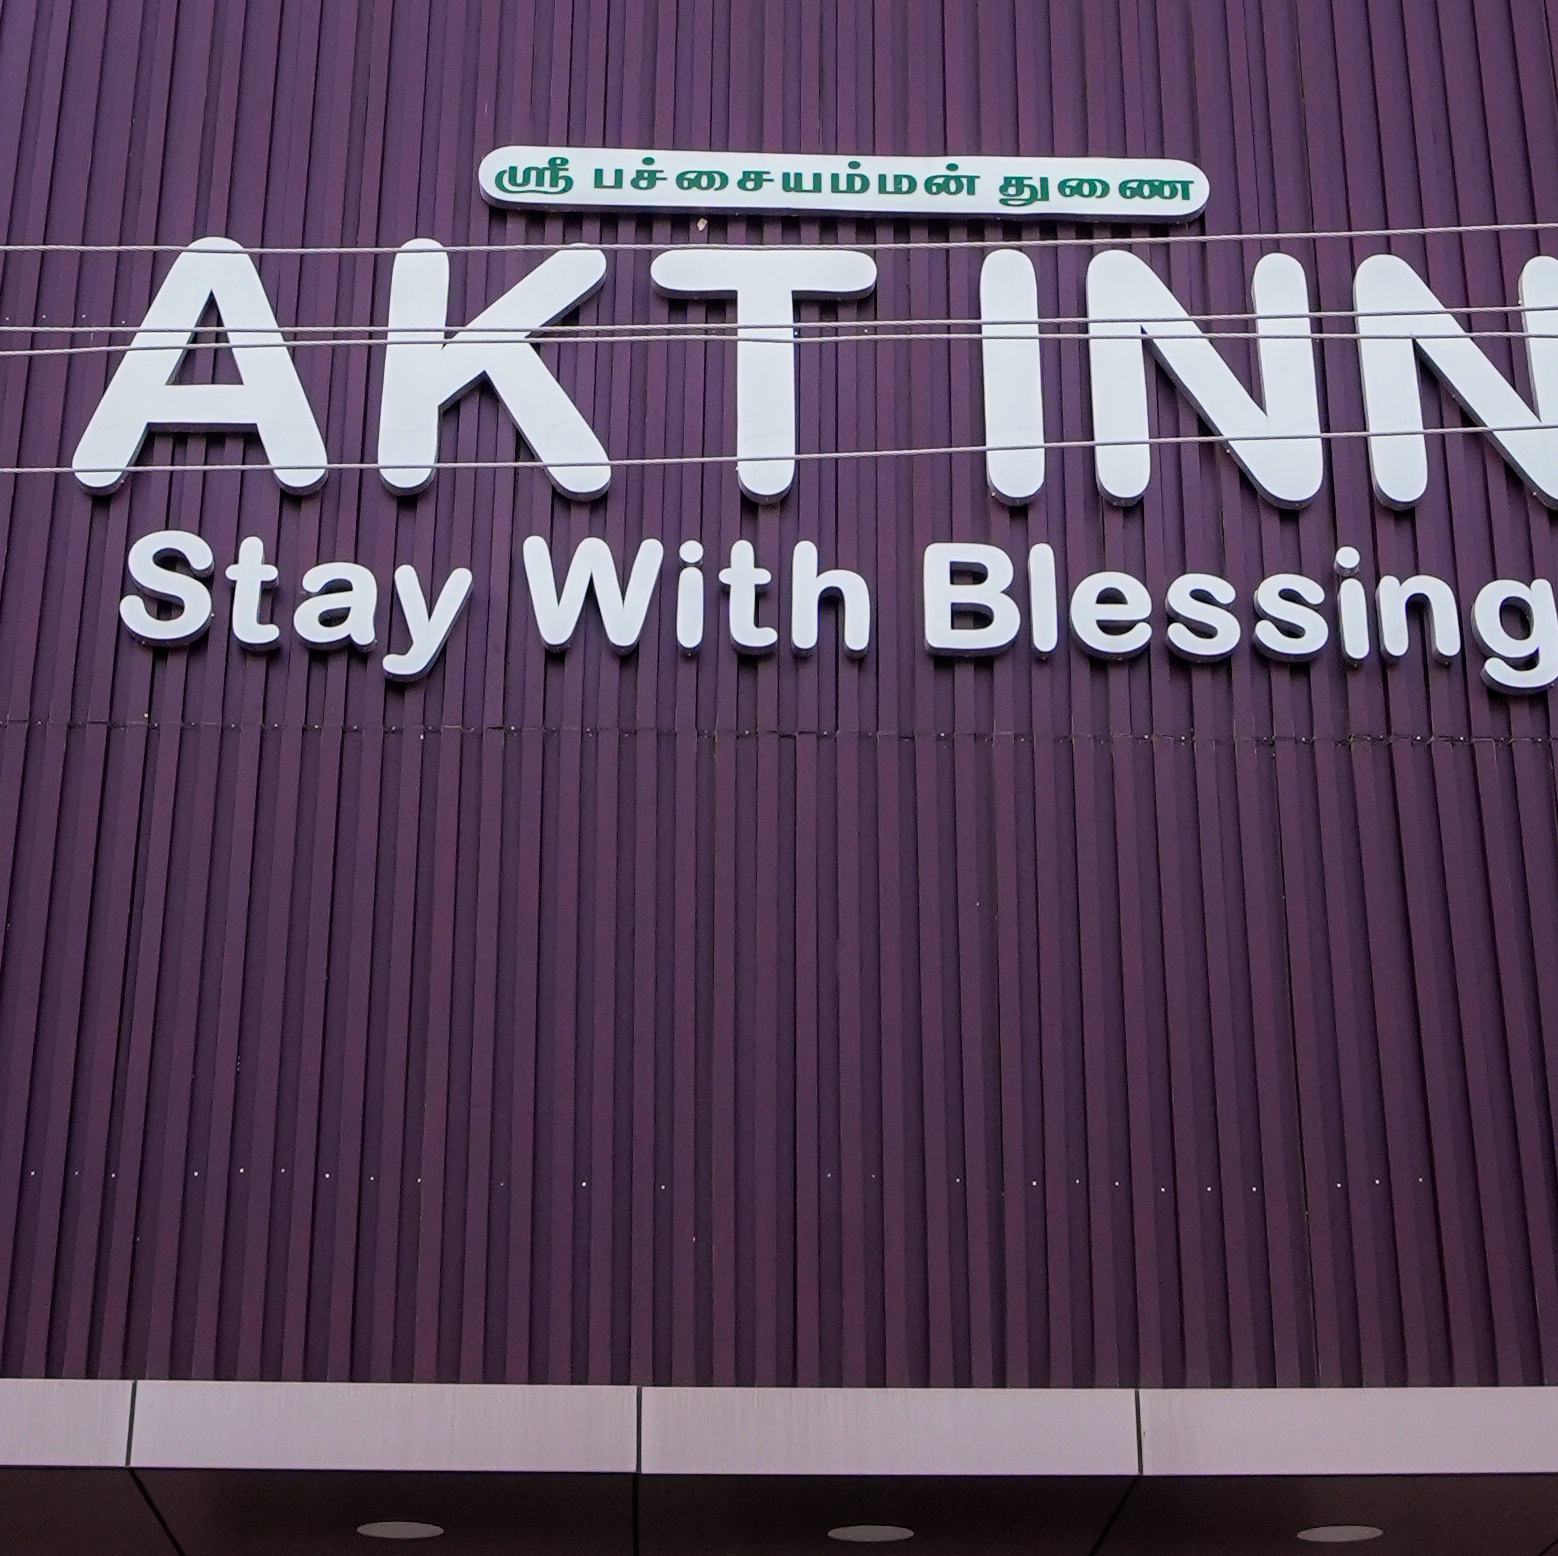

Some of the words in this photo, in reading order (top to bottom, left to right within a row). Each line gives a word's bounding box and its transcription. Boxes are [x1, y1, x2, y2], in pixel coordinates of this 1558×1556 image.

[493, 155, 574, 195] ஸ்ரீ
[594, 155, 979, 196] பச்சையம்மன்
[998, 174, 1193, 207] துணை
[71, 236, 877, 503] AKT
[120, 531, 473, 680] Stay
[523, 536, 872, 656] With
